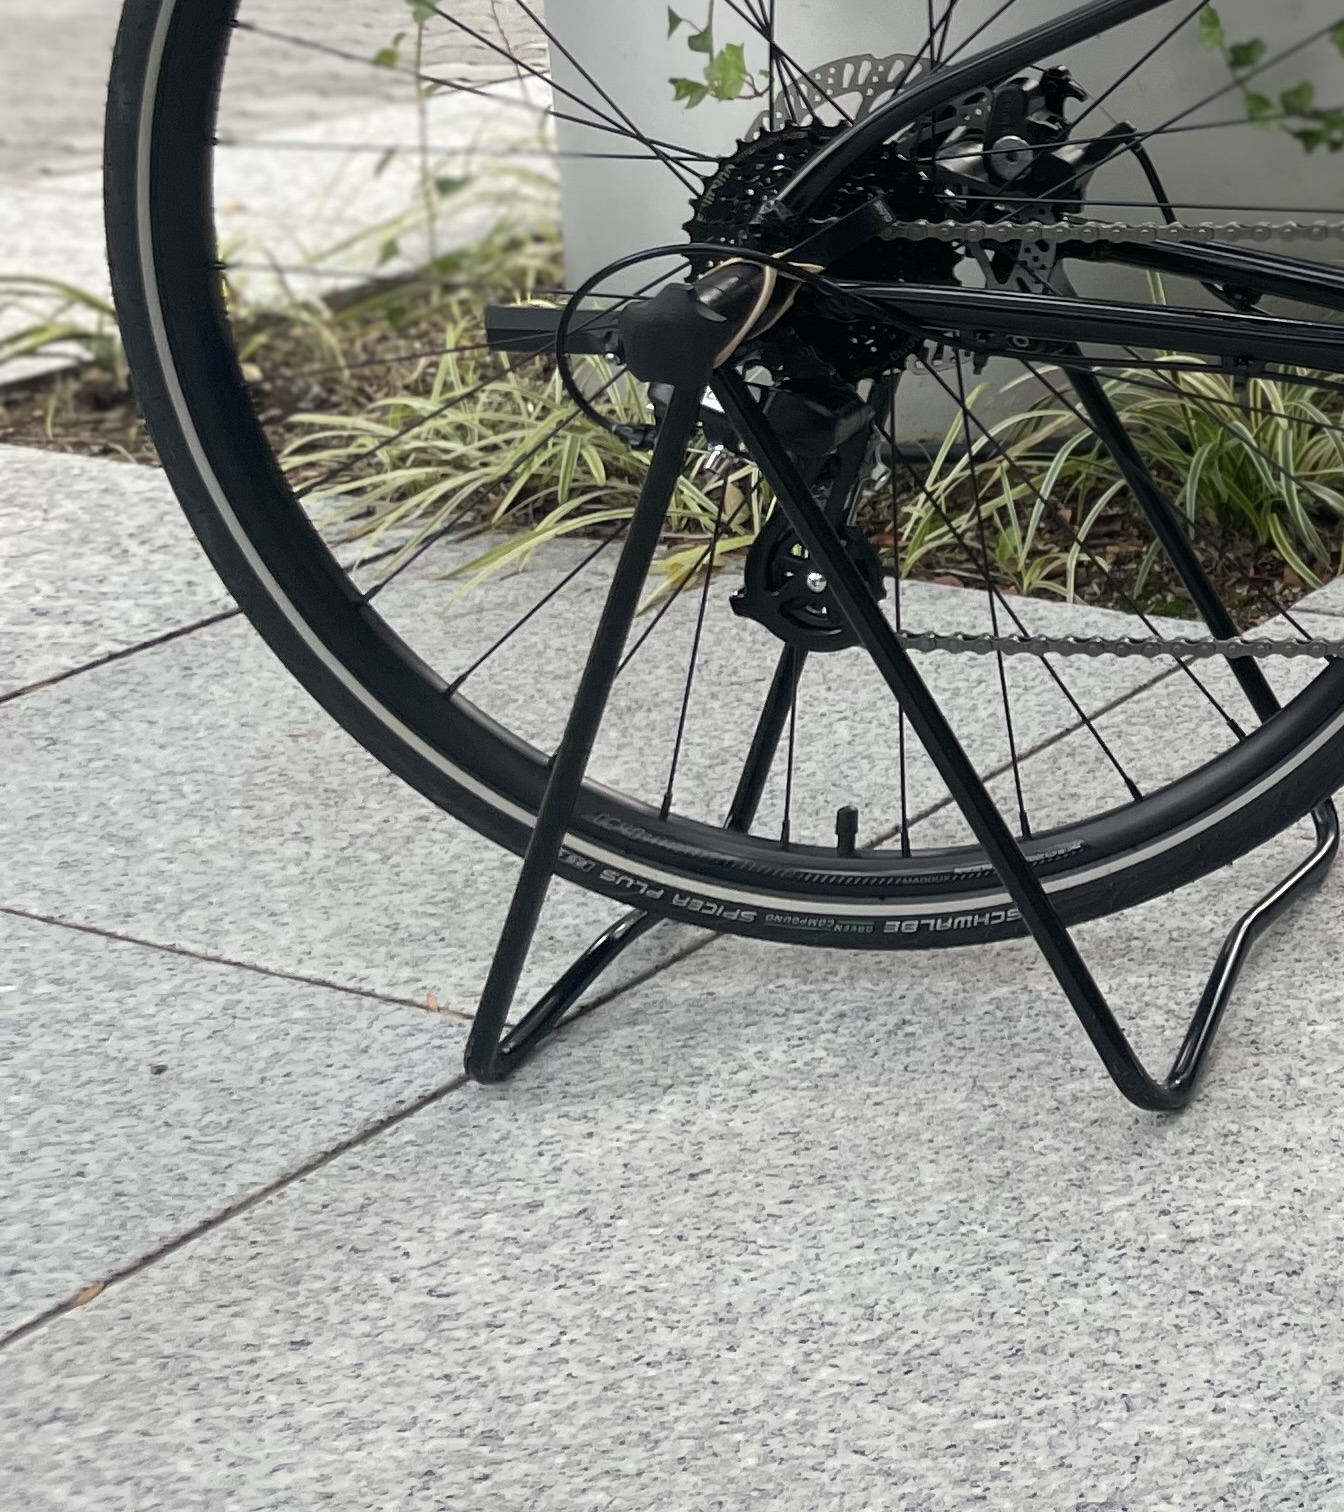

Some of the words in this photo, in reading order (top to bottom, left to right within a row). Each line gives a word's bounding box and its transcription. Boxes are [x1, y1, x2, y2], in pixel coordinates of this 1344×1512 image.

[599, 869, 665, 900] PLUS
[671, 893, 758, 923] SPICER
[883, 908, 1021, 934] SCHWALBE
